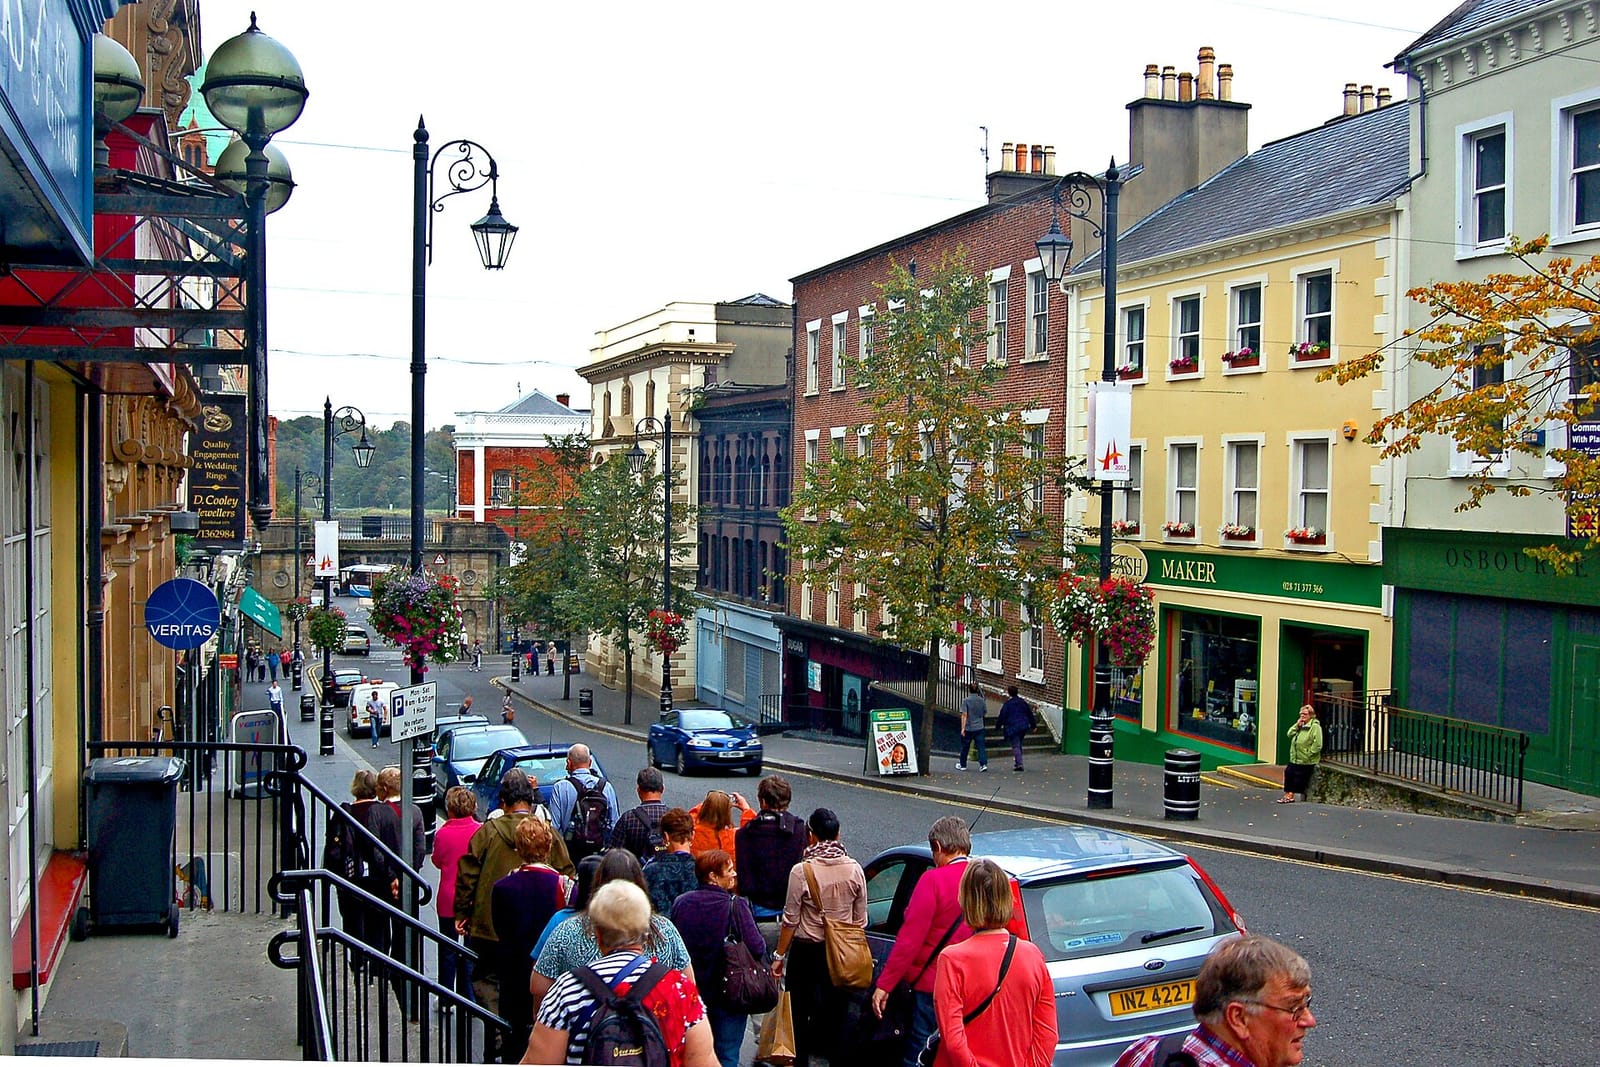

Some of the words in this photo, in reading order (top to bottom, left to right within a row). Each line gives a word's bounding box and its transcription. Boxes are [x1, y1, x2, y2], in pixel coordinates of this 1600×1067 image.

[1572, 435, 1588, 443] With
[202, 440, 230, 450] Quality
[193, 450, 239, 460] Engagement
[204, 462, 238, 472] Wedding
[206, 471, 227, 481] Rings
[197, 508, 235, 518] Jewellers
[1161, 558, 1217, 583] MAKER
[150, 624, 212, 636] VERITAS
[416, 706, 427, 714] Hour
[411, 717, 425, 725] return
[1119, 989, 1147, 1011] INZ
[1151, 982, 1191, 1006] 4227
